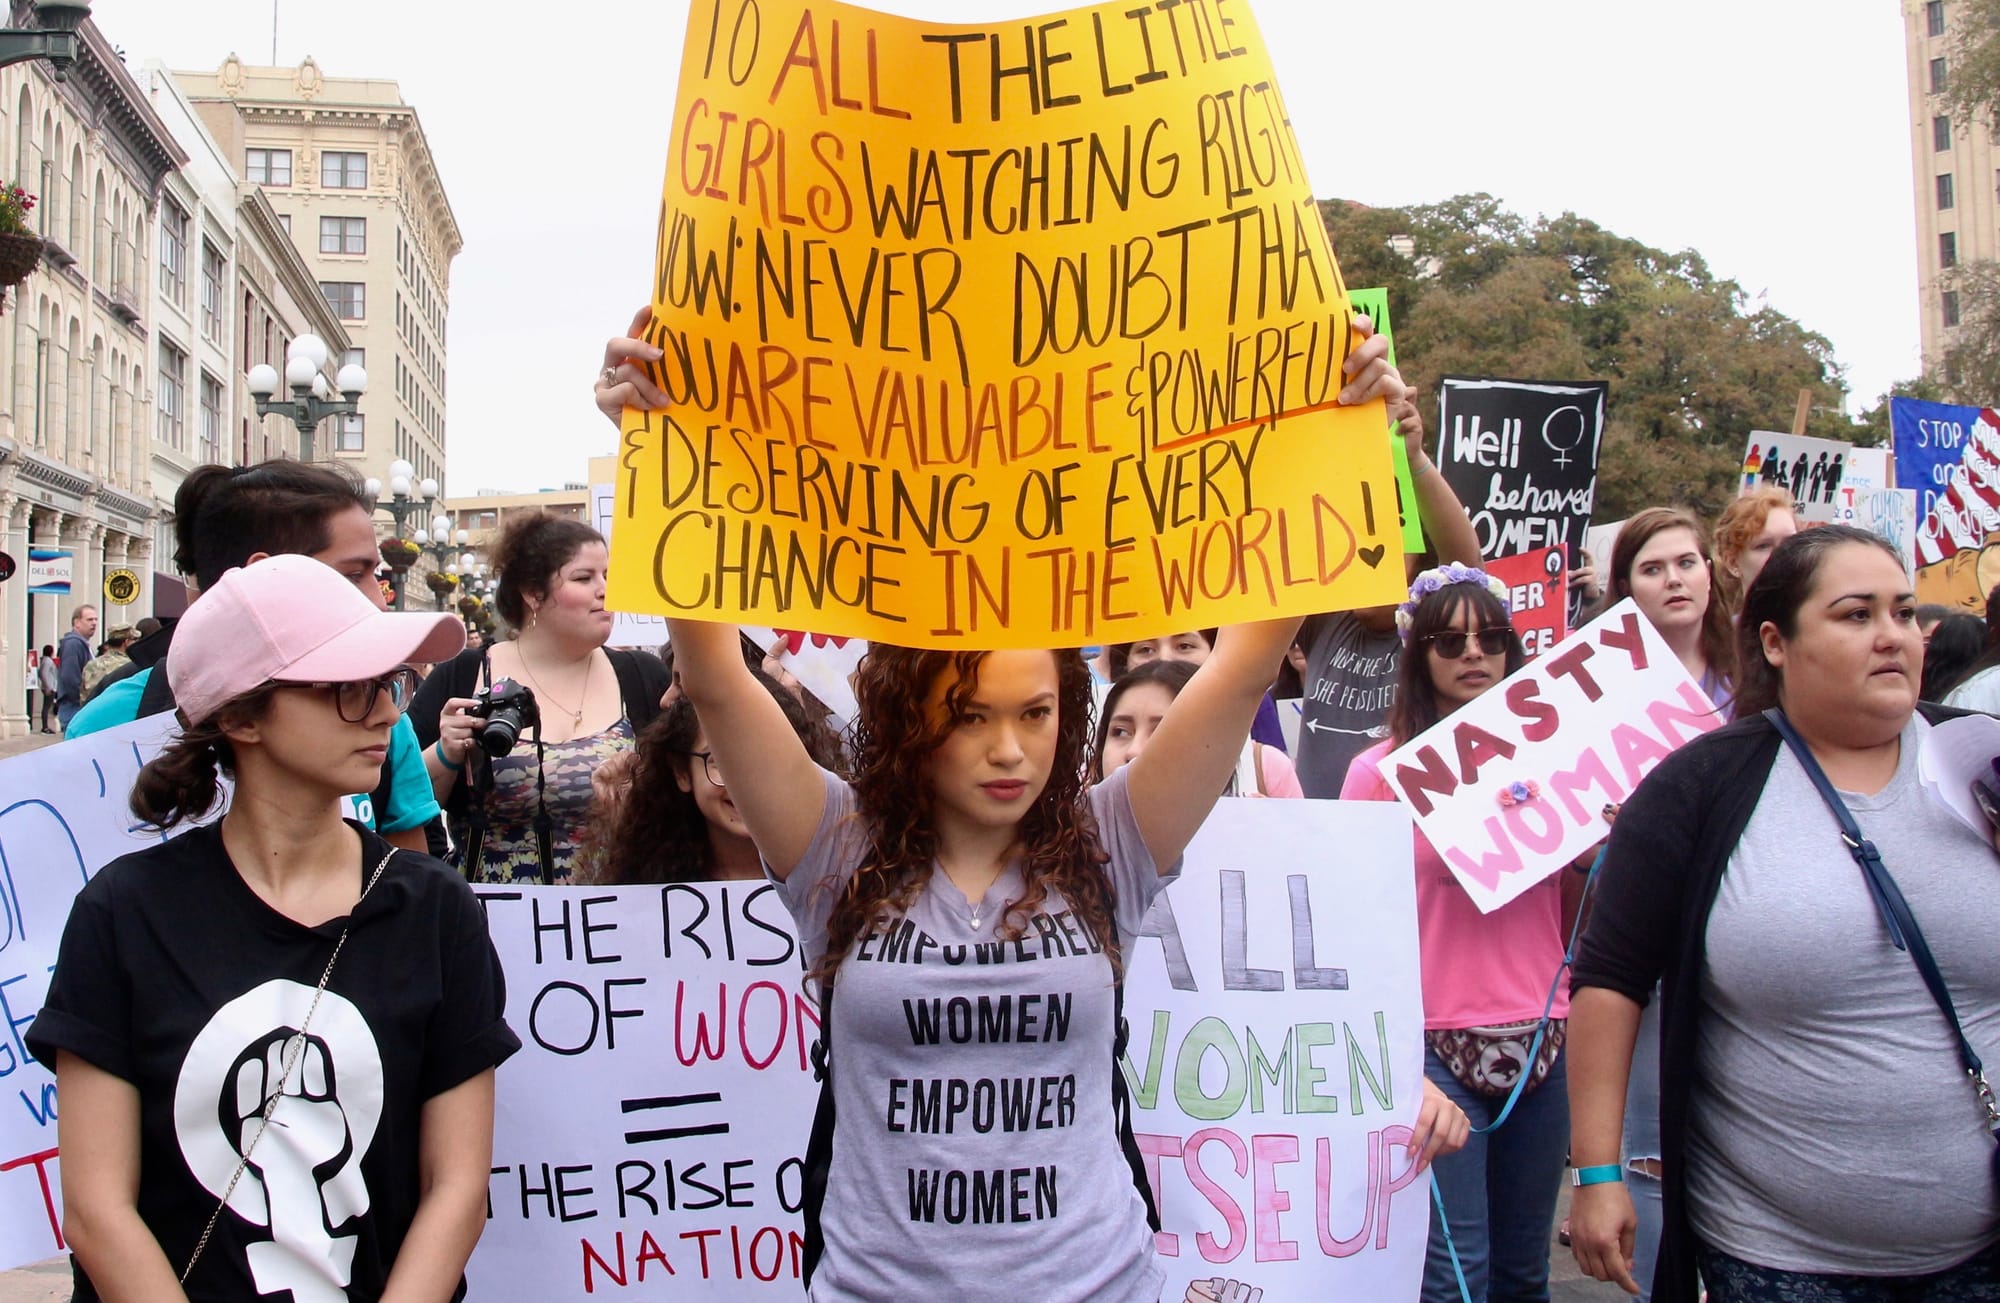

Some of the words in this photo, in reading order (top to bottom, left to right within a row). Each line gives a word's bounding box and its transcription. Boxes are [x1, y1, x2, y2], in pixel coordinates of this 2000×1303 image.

[768, 8, 912, 116] ALL
[921, 19, 1081, 123] THE
[1093, 0, 1247, 97] LITTLE
[681, 98, 853, 233] GIRLS
[860, 118, 1179, 244] WATCHING
[756, 227, 970, 387] NEVER
[1013, 219, 1211, 367] DOUBT
[1217, 195, 1344, 325] THAT
[726, 341, 837, 451] ARE
[845, 362, 1114, 472] VALUABLE
[1453, 414, 1522, 468] Well
[1918, 418, 1962, 448] STOP
[662, 415, 990, 548] DESERVING
[1015, 463, 1080, 540] OF
[1104, 424, 1266, 548] EVERY
[1485, 472, 1596, 516] behaved
[1933, 455, 1968, 486] and
[1463, 505, 1569, 558] OMEN
[1925, 490, 2000, 549] Bridge
[653, 511, 906, 622] CHANCE
[930, 546, 1010, 636] IN
[1026, 545, 1139, 637] THE
[1309, 678, 1339, 705] SHE
[1396, 613, 1649, 818] NASTY
[1445, 680, 1727, 893] WOMAN
[661, 884, 807, 970] RIS
[529, 977, 647, 1055] OF
[903, 992, 1072, 1046] WOMEN
[888, 1074, 1075, 1135] EMPOWER
[616, 1159, 753, 1218] RISE
[908, 1165, 1057, 1225] WOMEN
[1133, 1127, 1299, 1264] ISE
